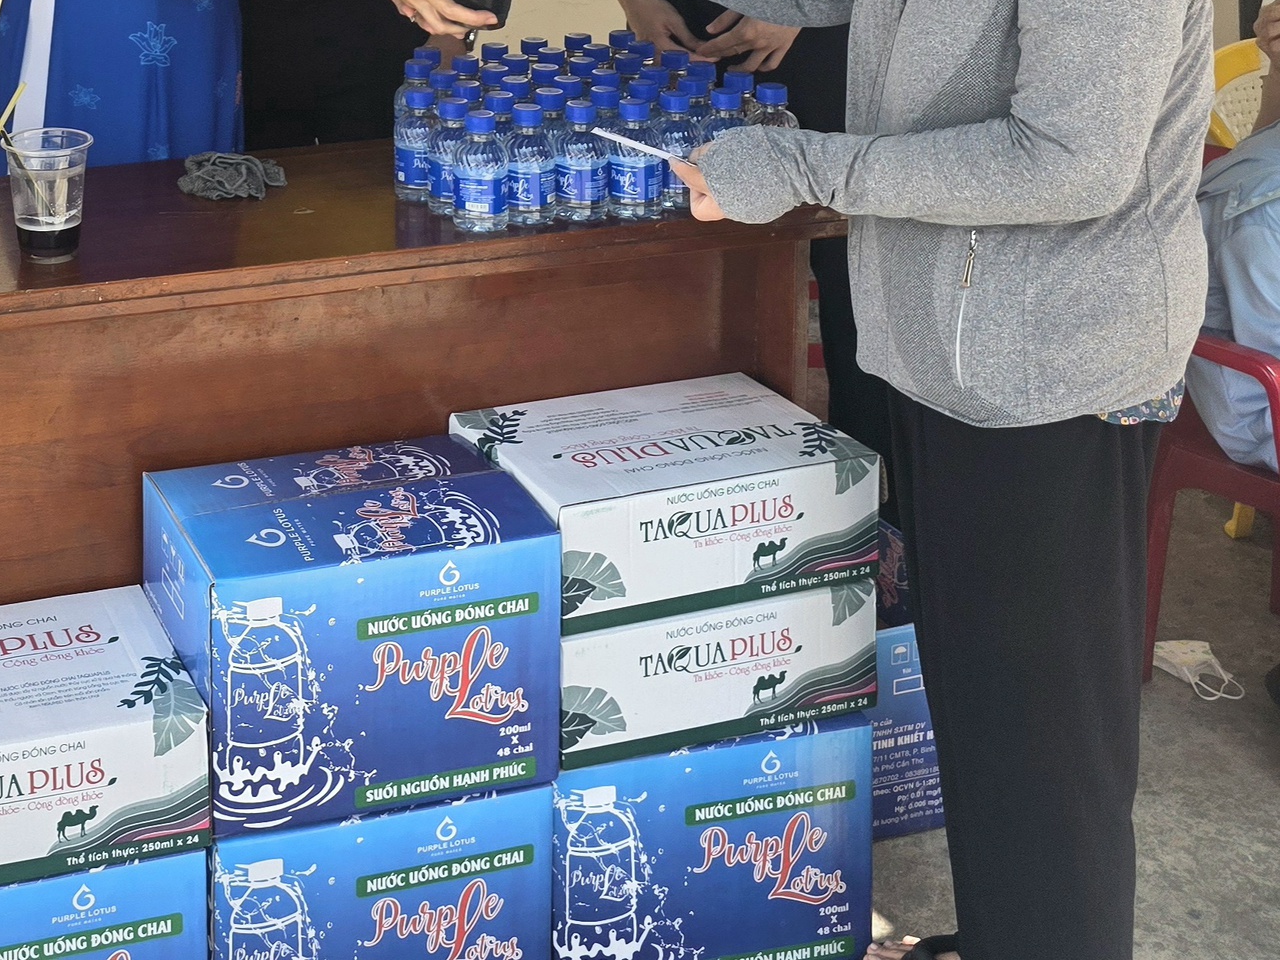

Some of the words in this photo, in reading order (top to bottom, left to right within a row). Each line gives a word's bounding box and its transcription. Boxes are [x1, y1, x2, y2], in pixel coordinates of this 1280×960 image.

[666, 493, 695, 505] NƯỚC
[697, 486, 724, 499] UỐNG
[726, 483, 755, 494] ĐÓNG
[757, 478, 780, 489] CHAI
[272, 507, 295, 532] LOTUS
[639, 494, 794, 542] TAQUAPLUS
[288, 531, 315, 562] PURPLE
[419, 587, 451, 598] PURPLE
[452, 583, 480, 592] LOTUS
[761, 581, 777, 594] Thể
[779, 578, 797, 589] tích
[798, 575, 821, 588] thực:
[823, 569, 850, 583] 250ml
[859, 565, 870, 574] 24
[26, 615, 58, 626] CHAI
[367, 616, 408, 635] NƯỚC
[411, 607, 452, 630] UỐNG
[455, 603, 495, 621] ĐÓNG
[498, 598, 529, 614] CHAI
[666, 626, 694, 640] NƯỚC
[696, 619, 724, 634] UỐNG
[725, 615, 754, 629] ĐÓNG
[756, 611, 778, 624] CHAI
[365, 626, 509, 702] Purple
[639, 627, 793, 678] TAQUAPLUS
[760, 714, 775, 727] Thể
[777, 711, 795, 722] tích
[797, 708, 820, 720] thực:
[821, 701, 847, 715] 250ml
[857, 698, 868, 707] 24
[499, 723, 531, 737] 200ml
[872, 737, 895, 750] TINH
[897, 730, 924, 746] KHIẾT
[22, 745, 57, 760] ĐÓNG
[59, 740, 86, 752] CHAI
[497, 746, 510, 757] 48
[366, 782, 398, 803] SUỐI
[401, 774, 450, 797] NGUỒN
[453, 768, 492, 789] HẠNH
[493, 761, 526, 780] PHÚC
[743, 776, 772, 786] PURPLE
[774, 771, 799, 780] LOTUS
[695, 803, 733, 821] NƯỚC
[736, 797, 773, 815] UỐNG
[776, 791, 813, 808] ĐÓNG
[817, 786, 846, 801] CHAI
[66, 853, 86, 866] Thể
[87, 850, 109, 863] tích
[111, 847, 139, 861] thực:
[142, 837, 174, 853] 250ml
[186, 834, 200, 844] 24
[417, 842, 448, 854] PURPLE
[450, 837, 476, 848] LOTUS
[692, 812, 828, 883] Purple
[366, 873, 406, 893] NƯỚC
[409, 865, 448, 885] UỐNG
[452, 857, 490, 876] ĐÓNG
[494, 850, 524, 867] CHAI
[51, 912, 86, 924] PURPLE
[88, 905, 117, 917] LOTUS
[363, 878, 505, 954] Purple
[819, 903, 849, 916] 200ml
[43, 936, 88, 956] UỐNG
[90, 927, 134, 949] ĐÓNG
[137, 919, 172, 938] CHAI
[817, 926, 830, 936] 48
